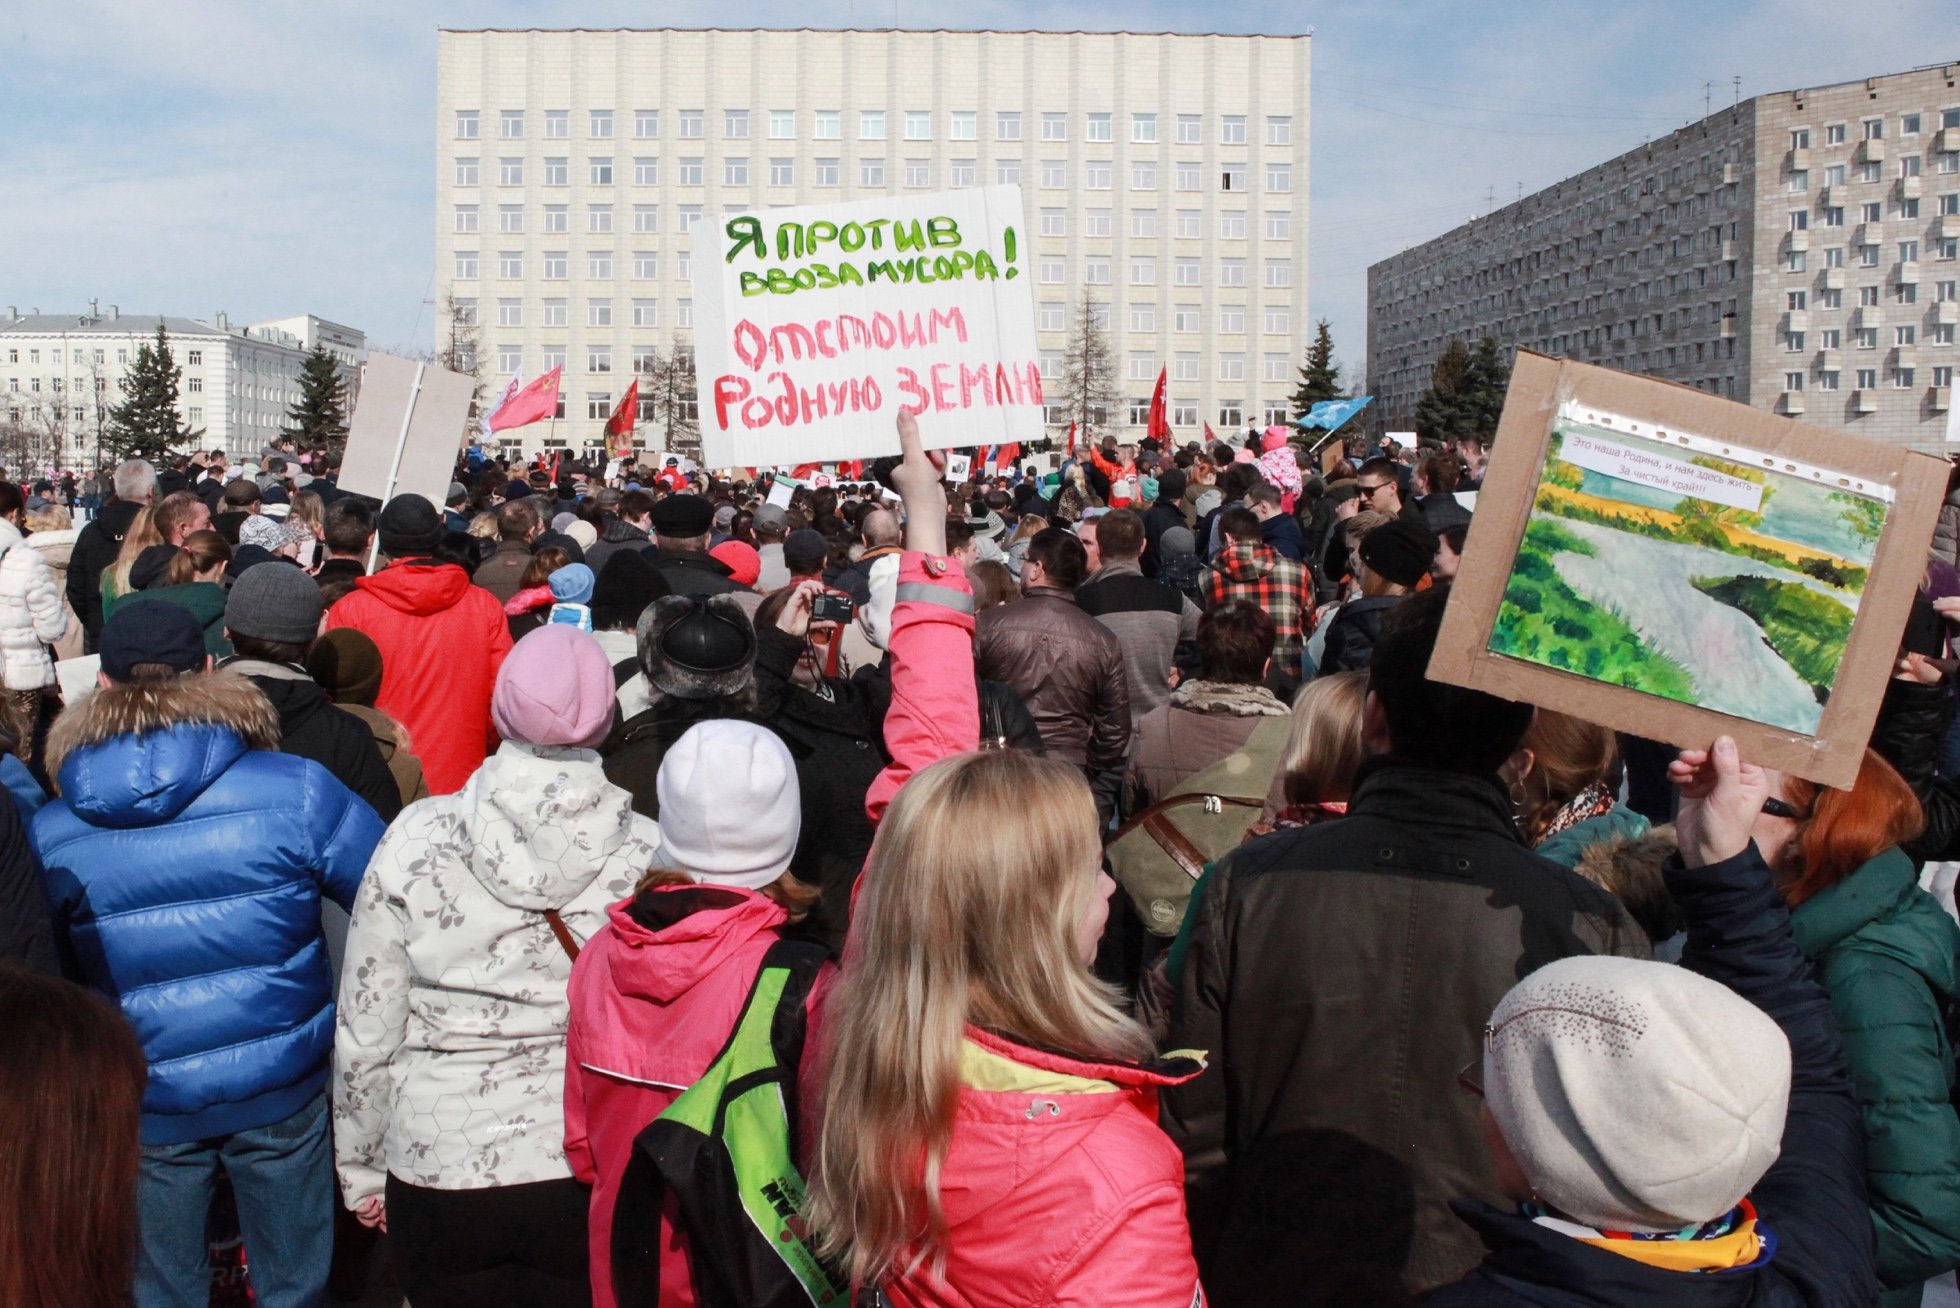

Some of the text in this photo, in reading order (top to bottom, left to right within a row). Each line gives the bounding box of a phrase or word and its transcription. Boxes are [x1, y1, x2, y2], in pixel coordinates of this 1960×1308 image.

[726, 217, 961, 263] Я ПРОТИВ
[741, 227, 1018, 297] ВВОЗА МУСОРА!
[1573, 436, 1592, 450] Это
[1593, 443, 1621, 458] наша
[1623, 451, 1662, 469] Родина,
[1665, 462, 1673, 471] и
[1675, 464, 1695, 476] нам
[1696, 470, 1724, 485] здесь
[1727, 478, 1753, 492] жить
[1617, 464, 1707, 495] За чистый край!!!
